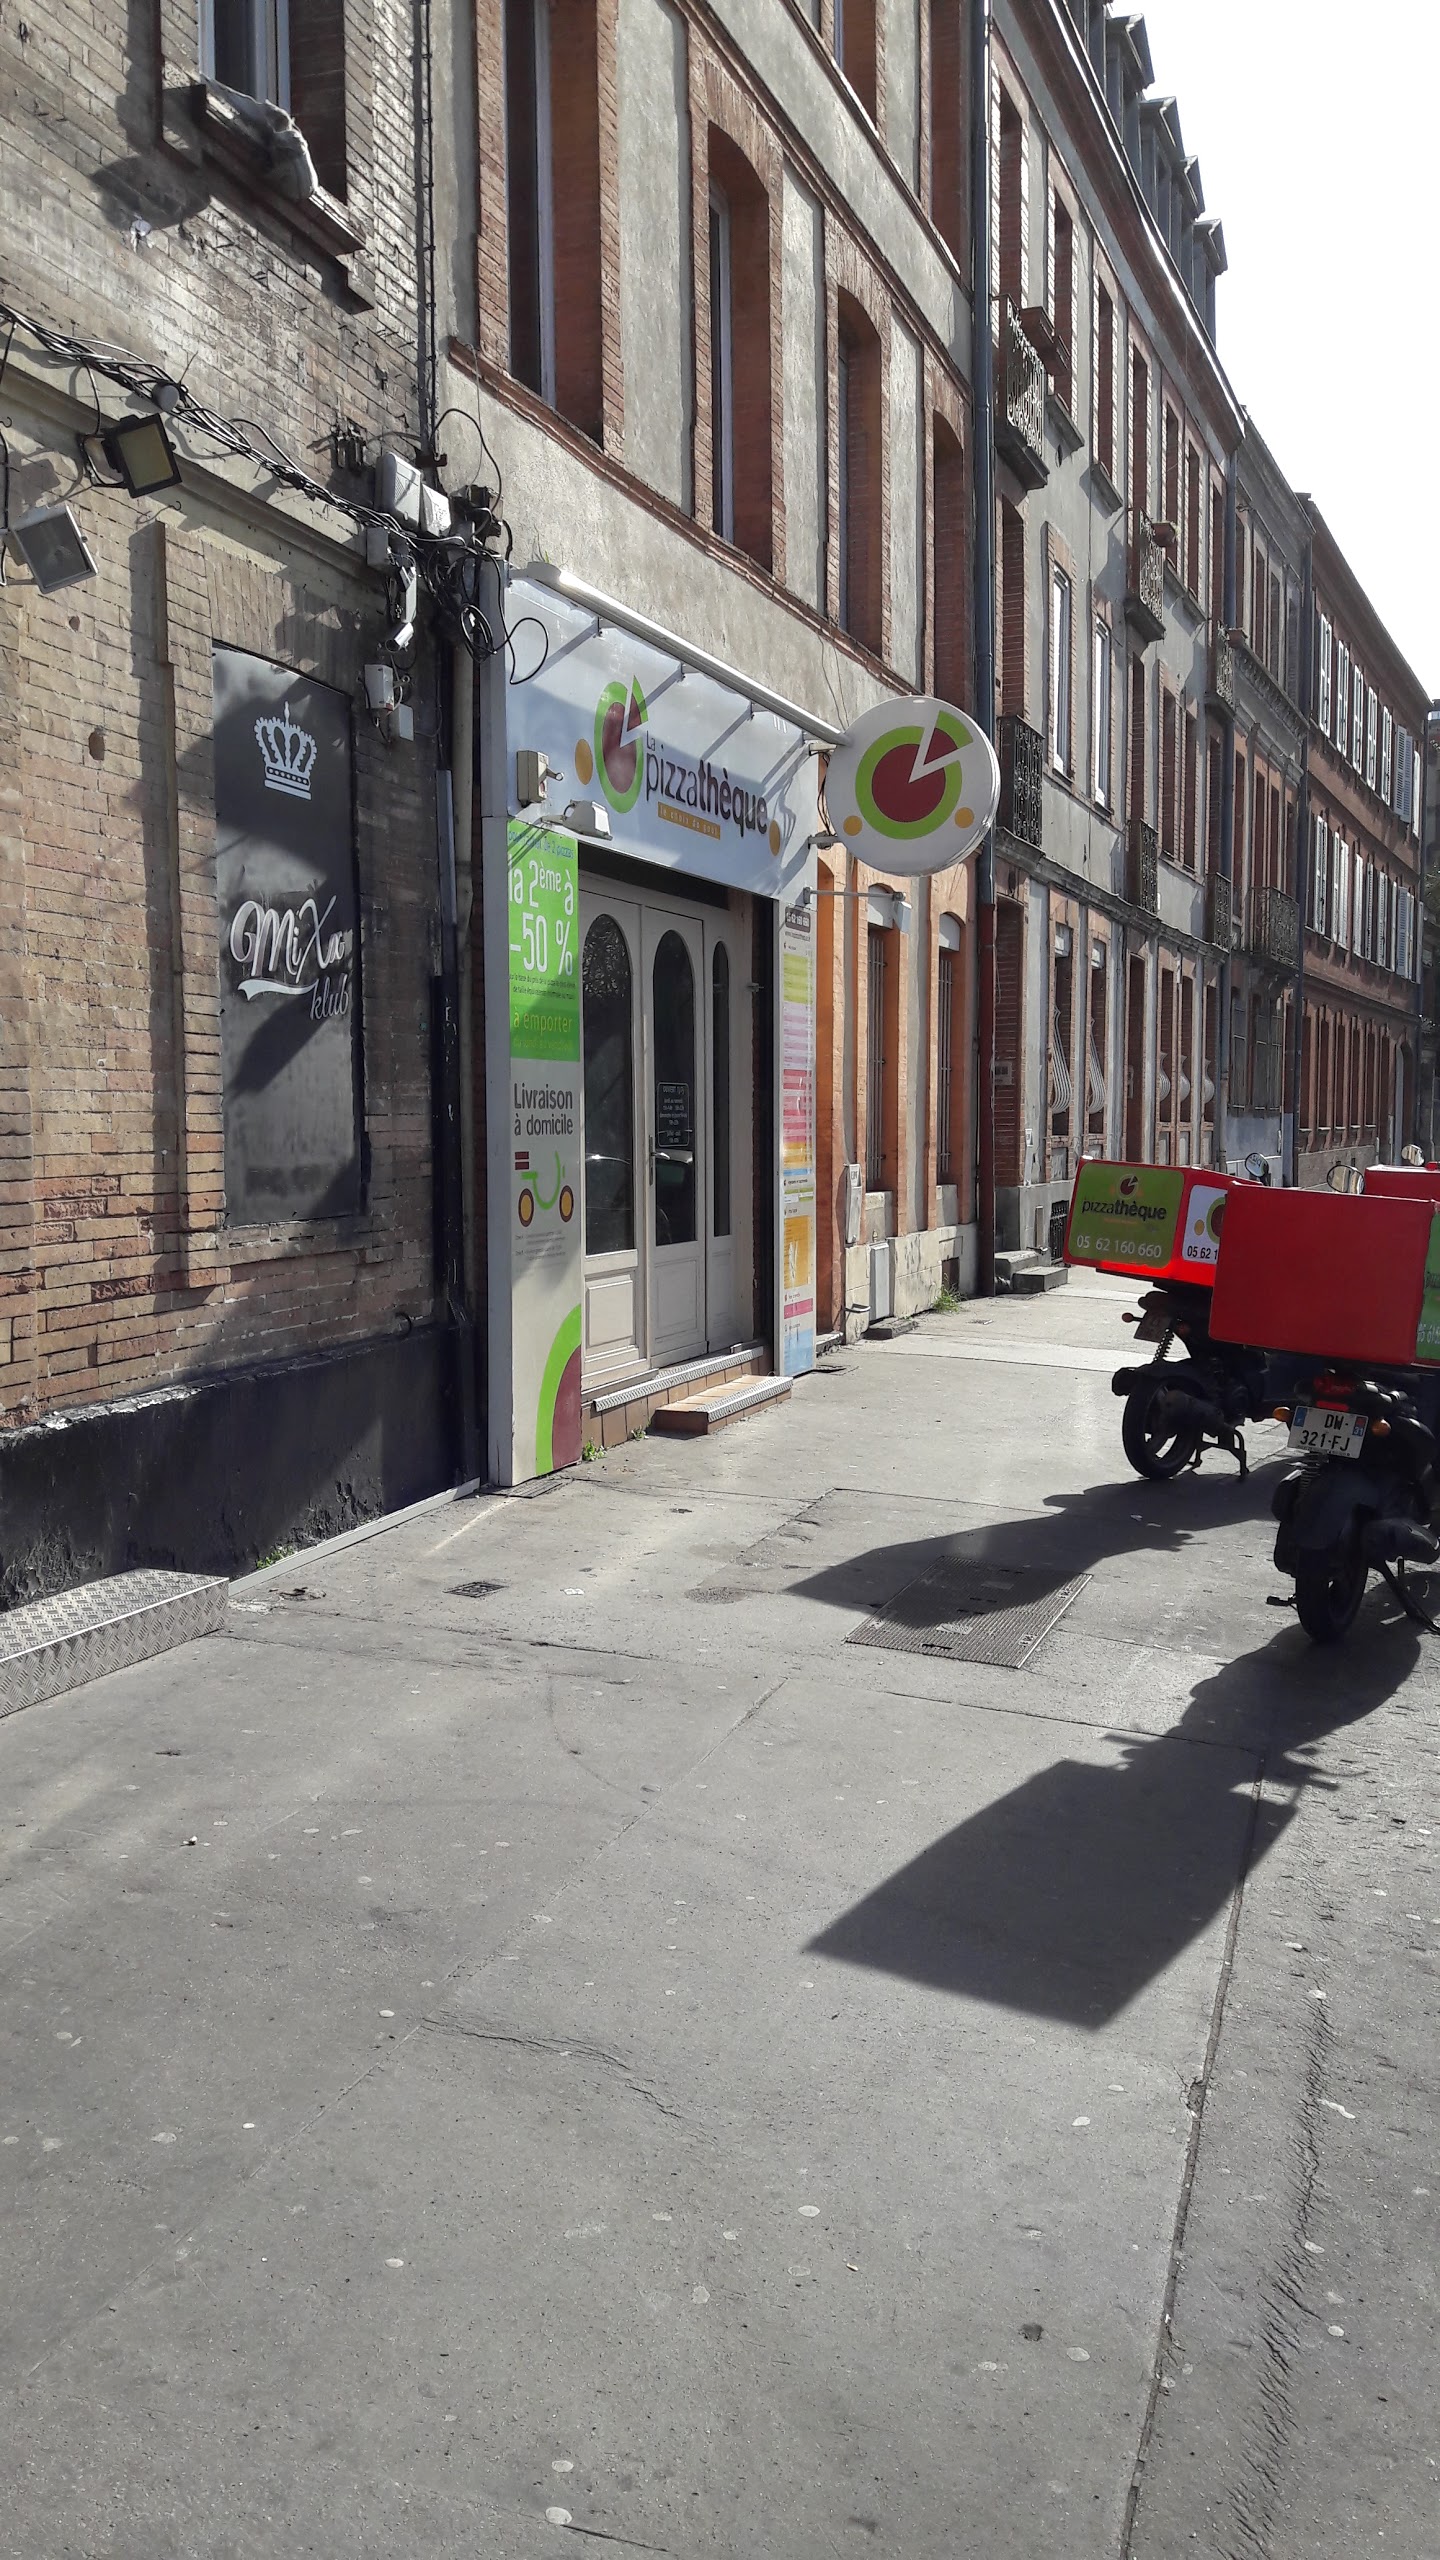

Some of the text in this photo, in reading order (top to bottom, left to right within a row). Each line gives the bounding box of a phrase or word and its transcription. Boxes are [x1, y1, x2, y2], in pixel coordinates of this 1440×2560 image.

[646, 730, 656, 752] La
[646, 744, 768, 838] pizzathèque
[508, 853, 574, 917] la 2ème à
[510, 911, 574, 977] -50 %
[309, 973, 349, 1021] klub
[513, 1006, 573, 1036] à emporter
[514, 1083, 573, 1110] Livraison
[514, 1112, 574, 1137] à domicile
[1082, 1199, 1167, 1222] pizzathèque
[1076, 1234, 1162, 1258] 05 62 160 660
[1187, 1245, 1198, 1258] 05
[1199, 1247, 1211, 1259] 62
[1300, 1429, 1350, 1452] 321-FJ
[1353, 1426, 1364, 1436] 31
